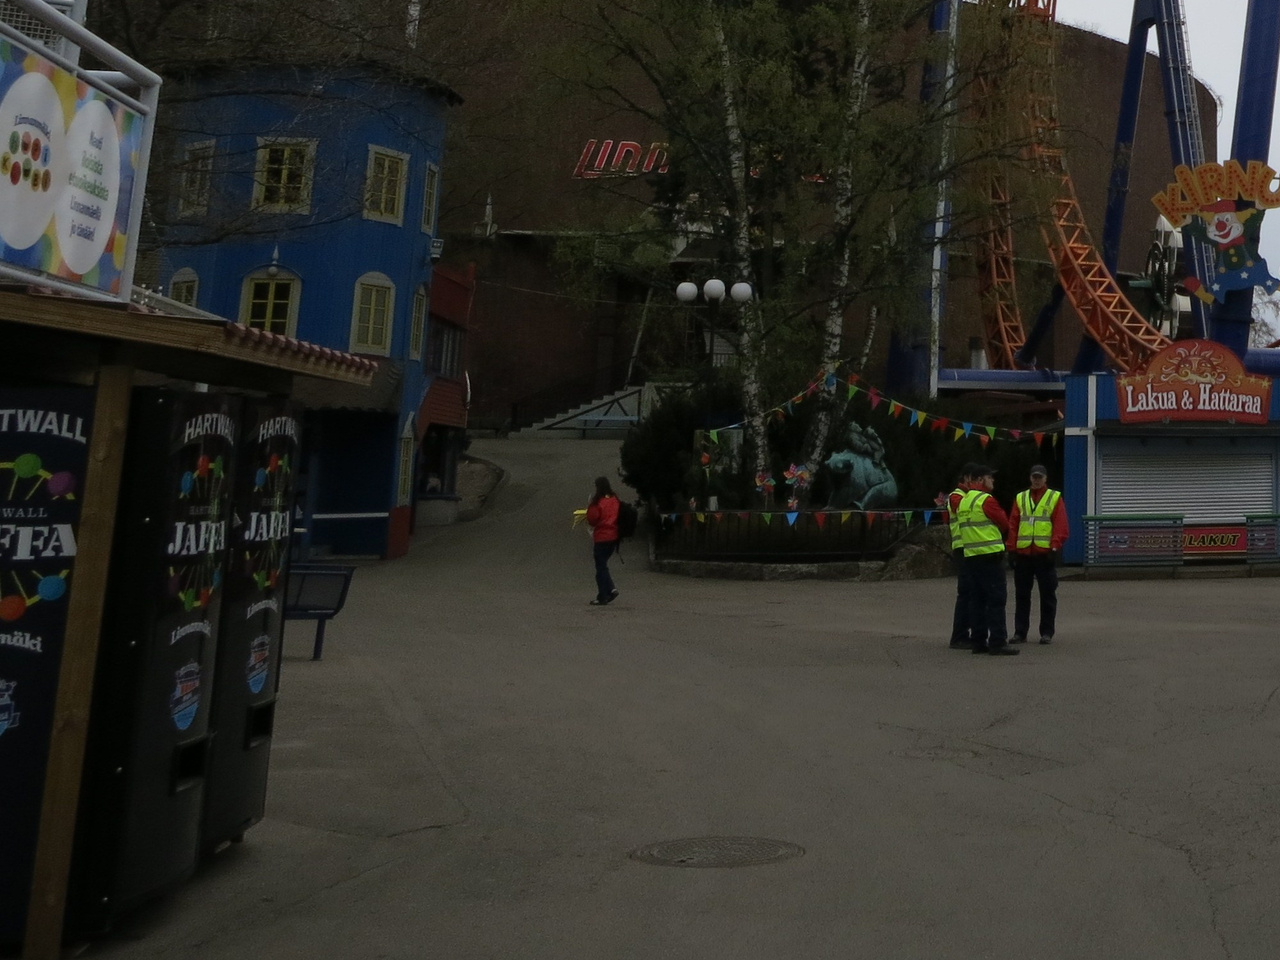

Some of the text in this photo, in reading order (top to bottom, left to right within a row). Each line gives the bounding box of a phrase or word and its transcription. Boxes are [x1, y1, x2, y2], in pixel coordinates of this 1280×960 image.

[1126, 383, 1262, 415] Lakua & Hattaraa
